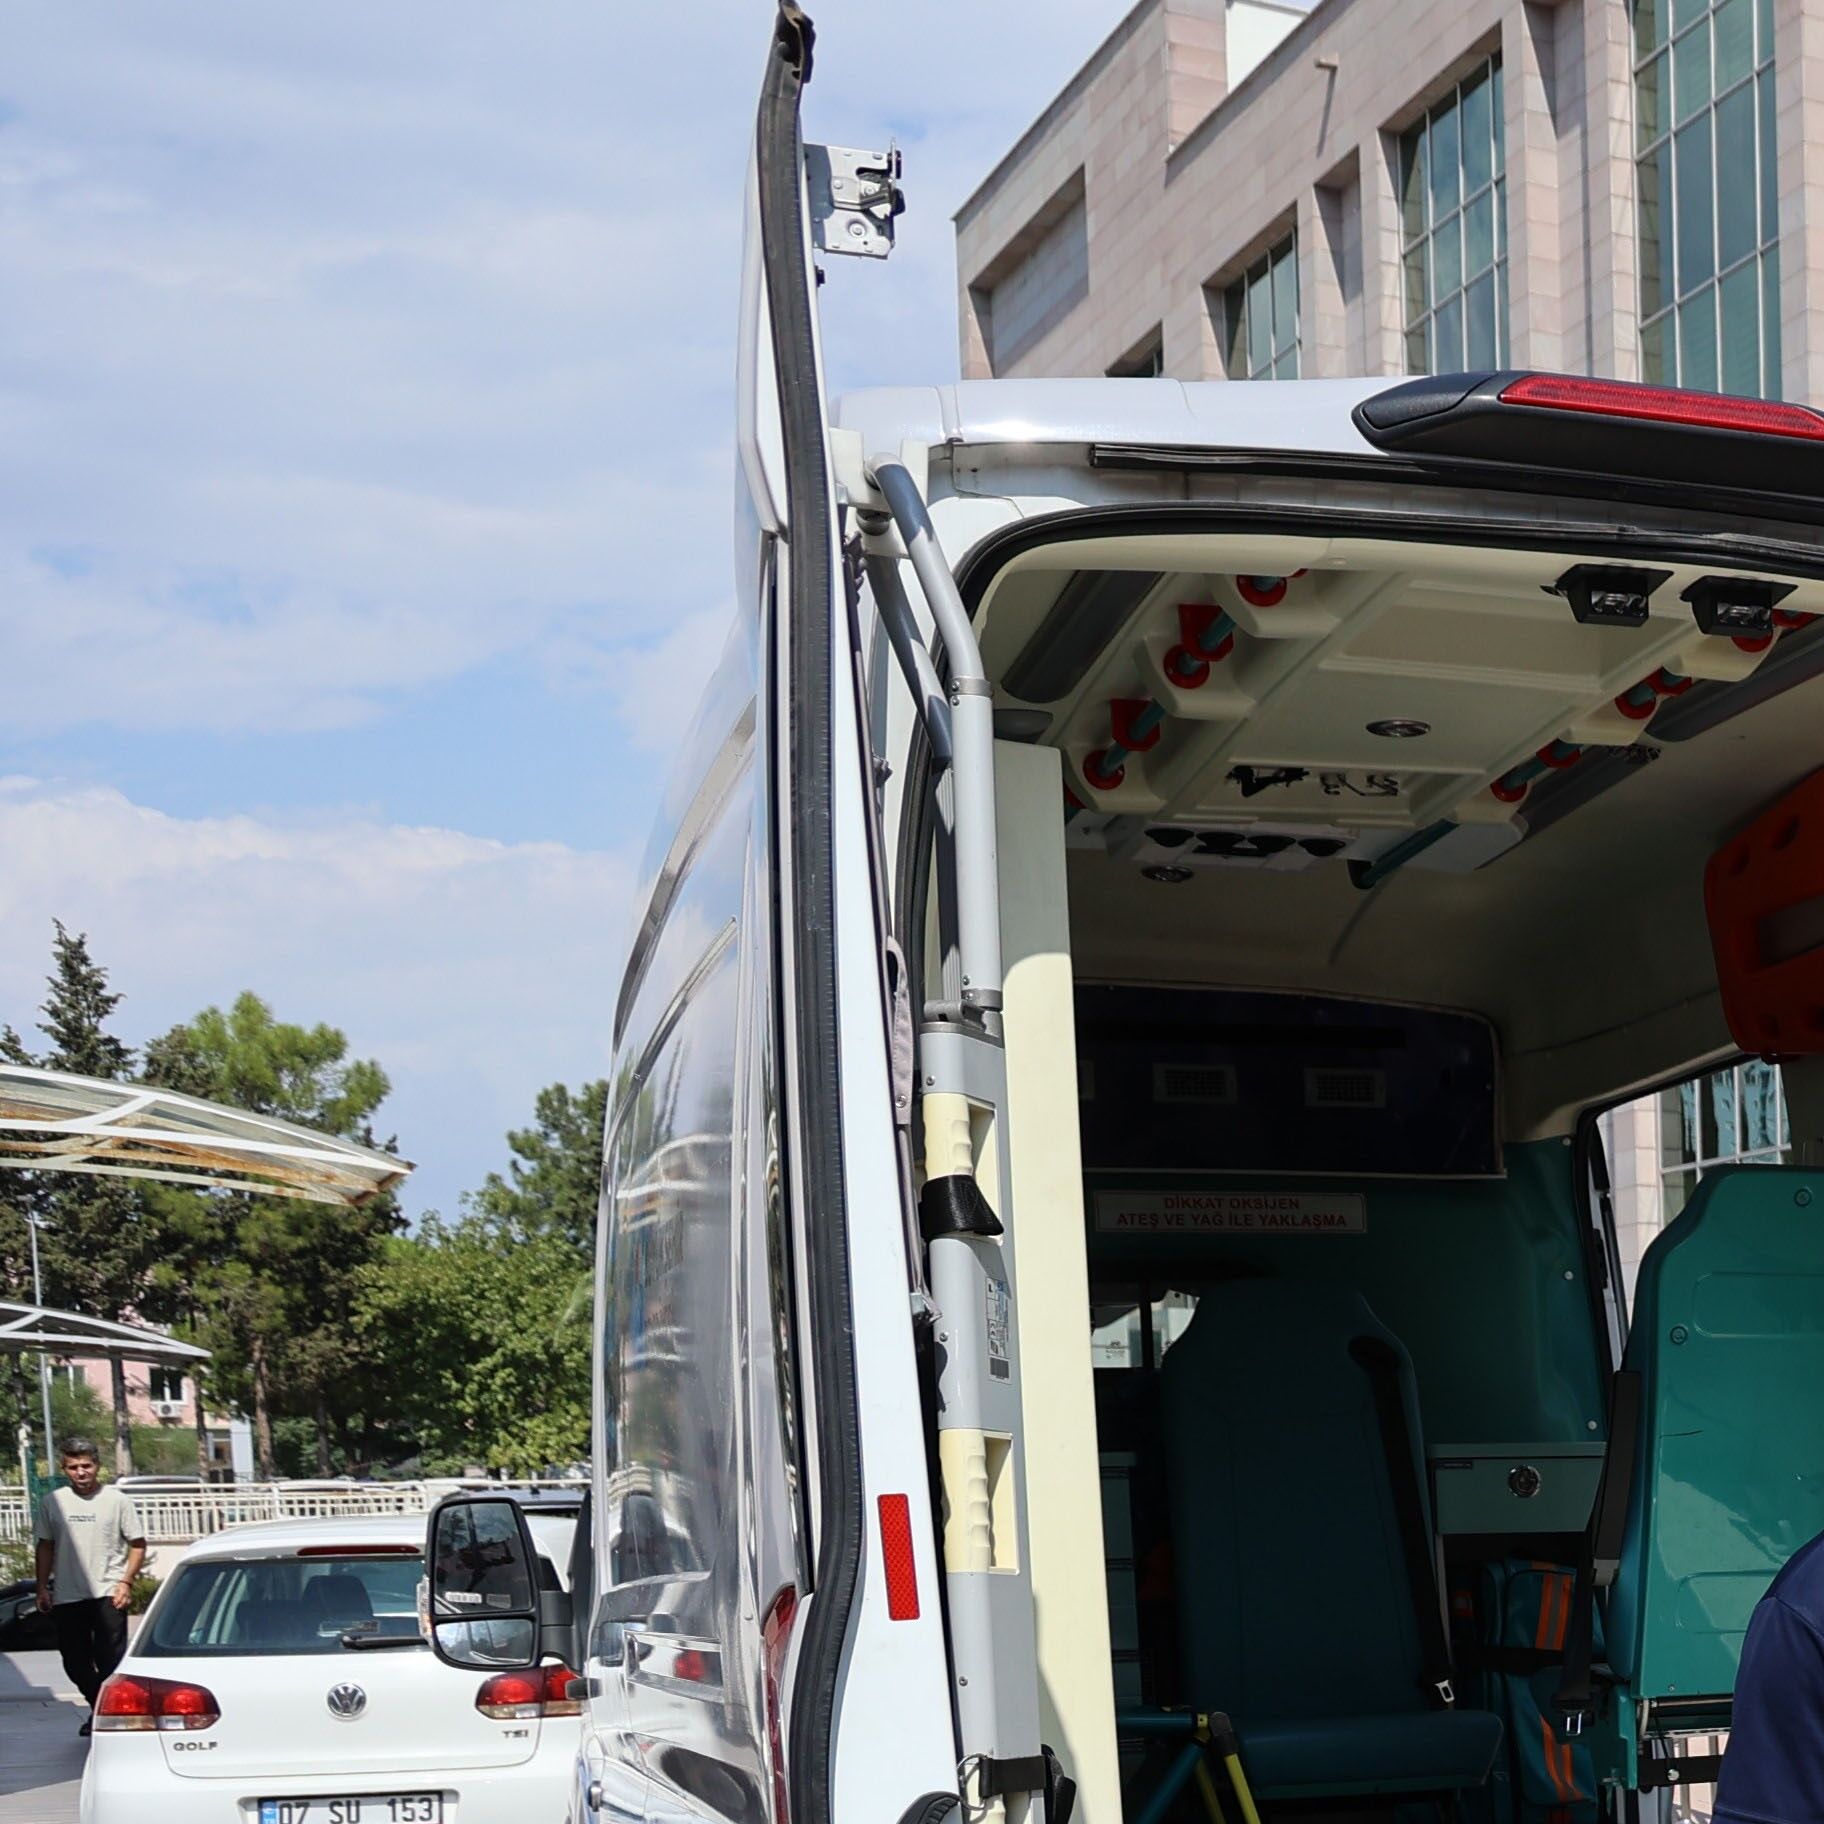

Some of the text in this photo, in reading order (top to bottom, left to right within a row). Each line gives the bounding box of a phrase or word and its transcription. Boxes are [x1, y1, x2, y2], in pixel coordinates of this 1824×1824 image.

[1163, 1195, 1301, 1209] DİKKAT OKSİJEN
[1117, 1210, 1347, 1229] ATEŞ VE YAĞ İLE YAKLAŞMA
[173, 1741, 218, 1752] GOLF
[387, 1797, 433, 1823] 153
